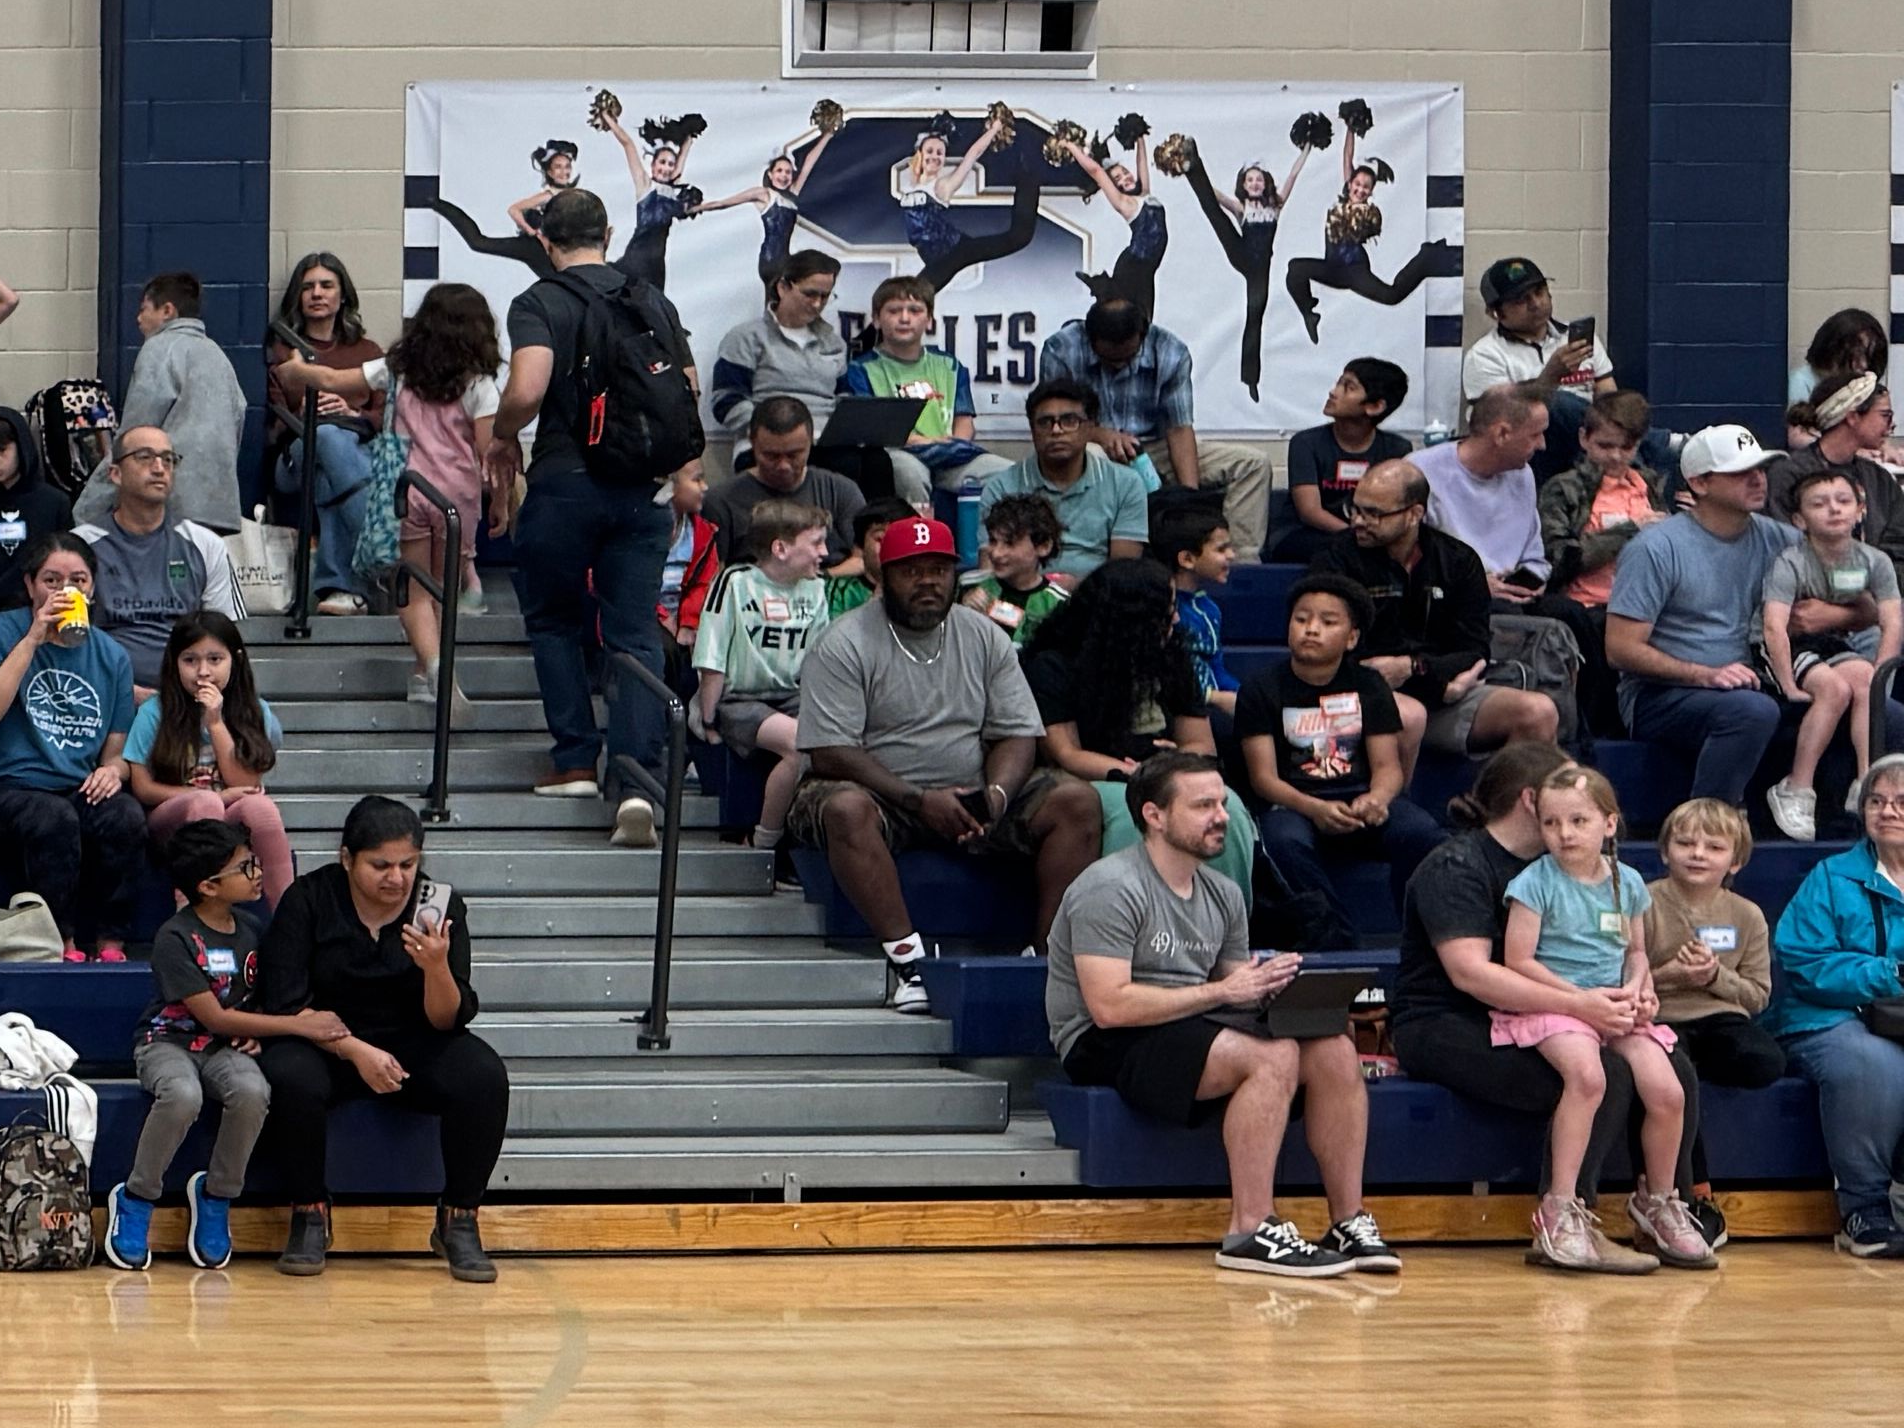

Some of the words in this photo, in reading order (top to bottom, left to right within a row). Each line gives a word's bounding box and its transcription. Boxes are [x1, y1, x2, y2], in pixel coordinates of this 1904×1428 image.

[838, 310, 1036, 384] ELES
[913, 523, 930, 544] B
[746, 625, 809, 650] YETI
[1150, 932, 1171, 953] 49
